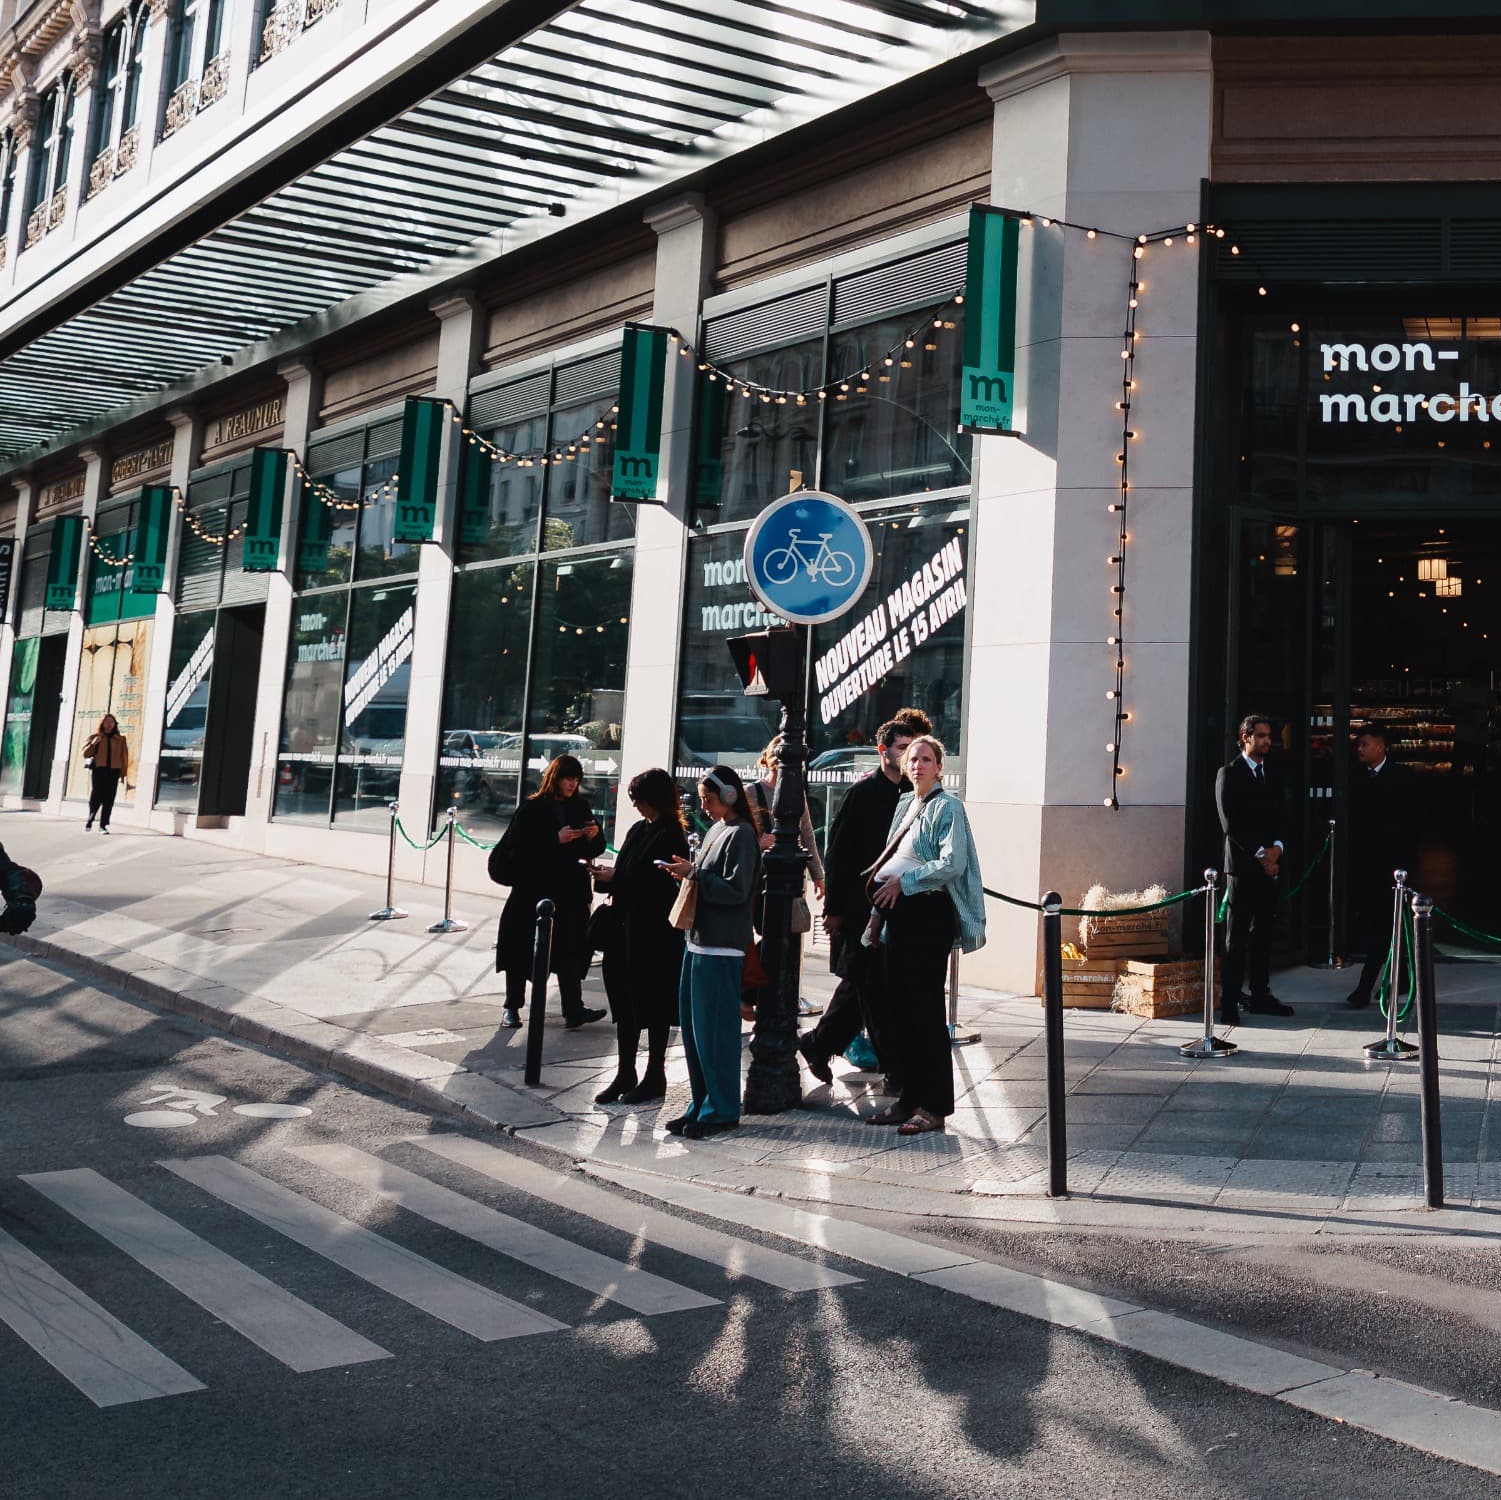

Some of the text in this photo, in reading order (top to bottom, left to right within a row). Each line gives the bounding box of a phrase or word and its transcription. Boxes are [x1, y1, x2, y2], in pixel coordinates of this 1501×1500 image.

[968, 374, 1008, 404] m
[1320, 342, 1459, 372] mon-
[815, 536, 963, 694] NOUVEAU MAGASIN
[820, 578, 968, 725] OUVERTURE LE 15 AVRIL
